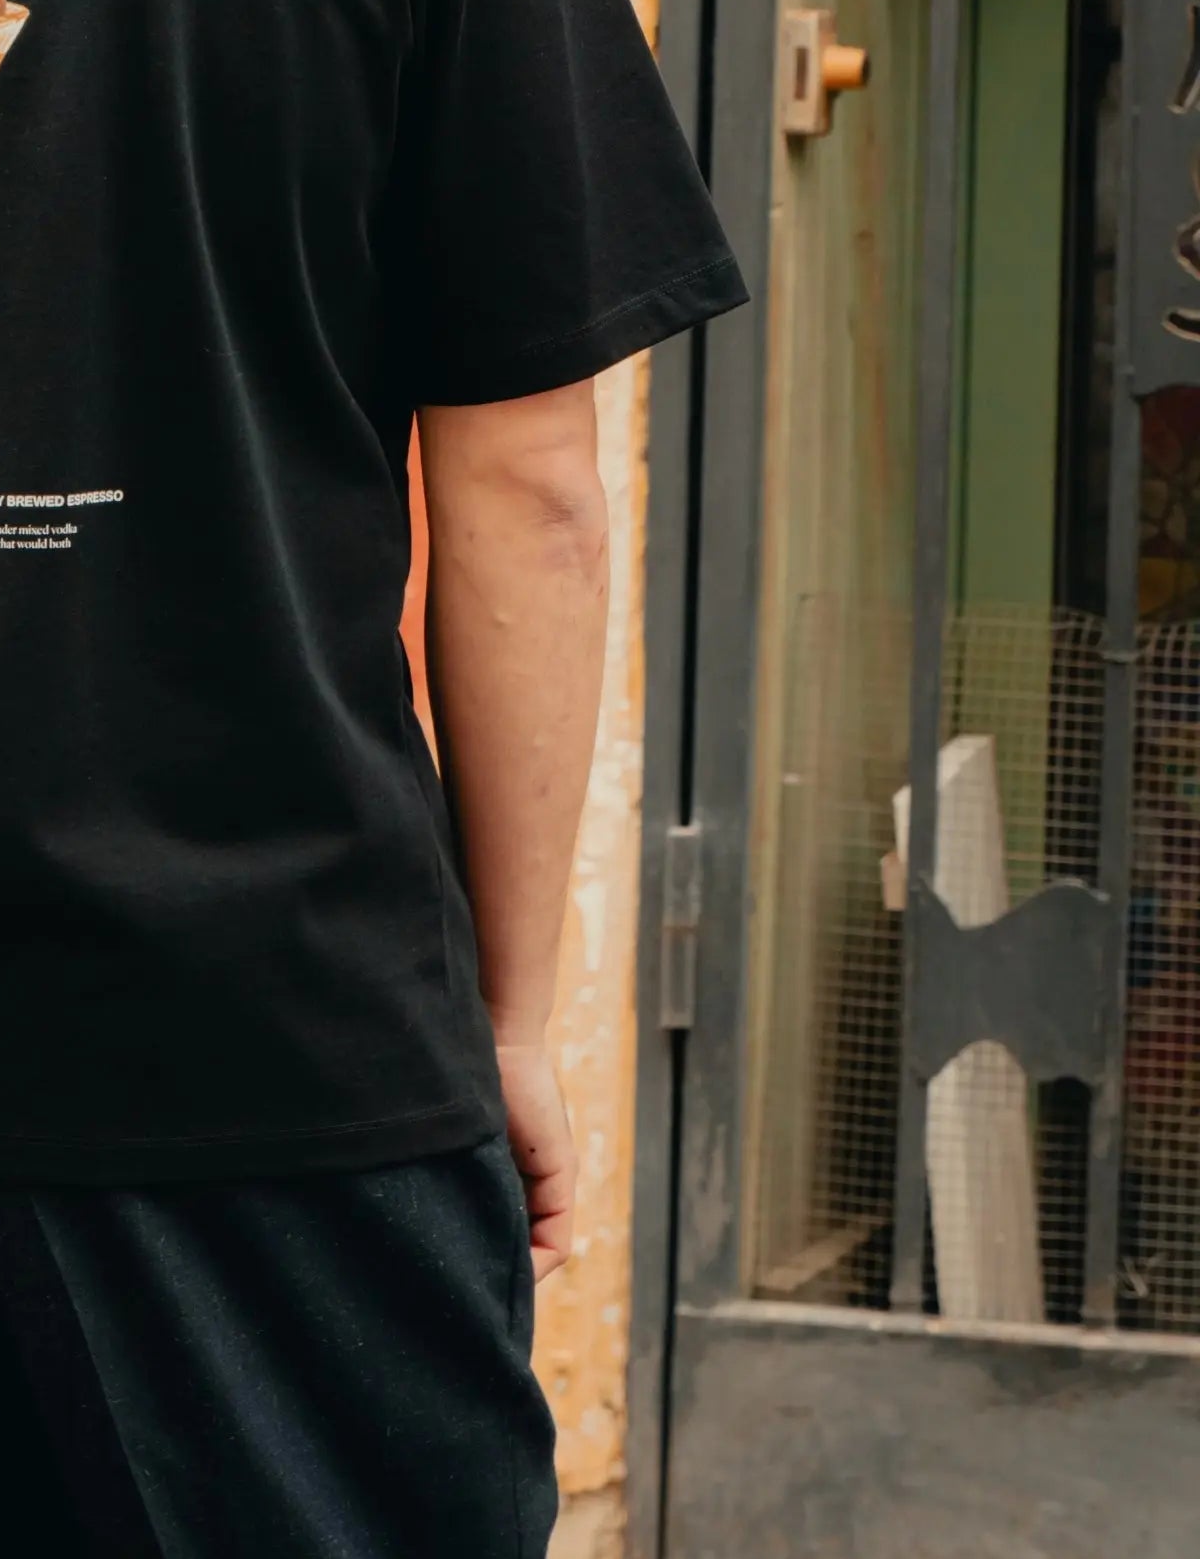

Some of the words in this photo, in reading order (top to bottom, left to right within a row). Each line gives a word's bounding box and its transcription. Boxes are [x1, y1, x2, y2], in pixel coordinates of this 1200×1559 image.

[6, 494, 65, 508] BREWED
[66, 489, 124, 507] ESPRESSO
[18, 525, 50, 536] mixed
[50, 523, 78, 535] vodka
[16, 538, 48, 550] would
[49, 538, 72, 549] both
